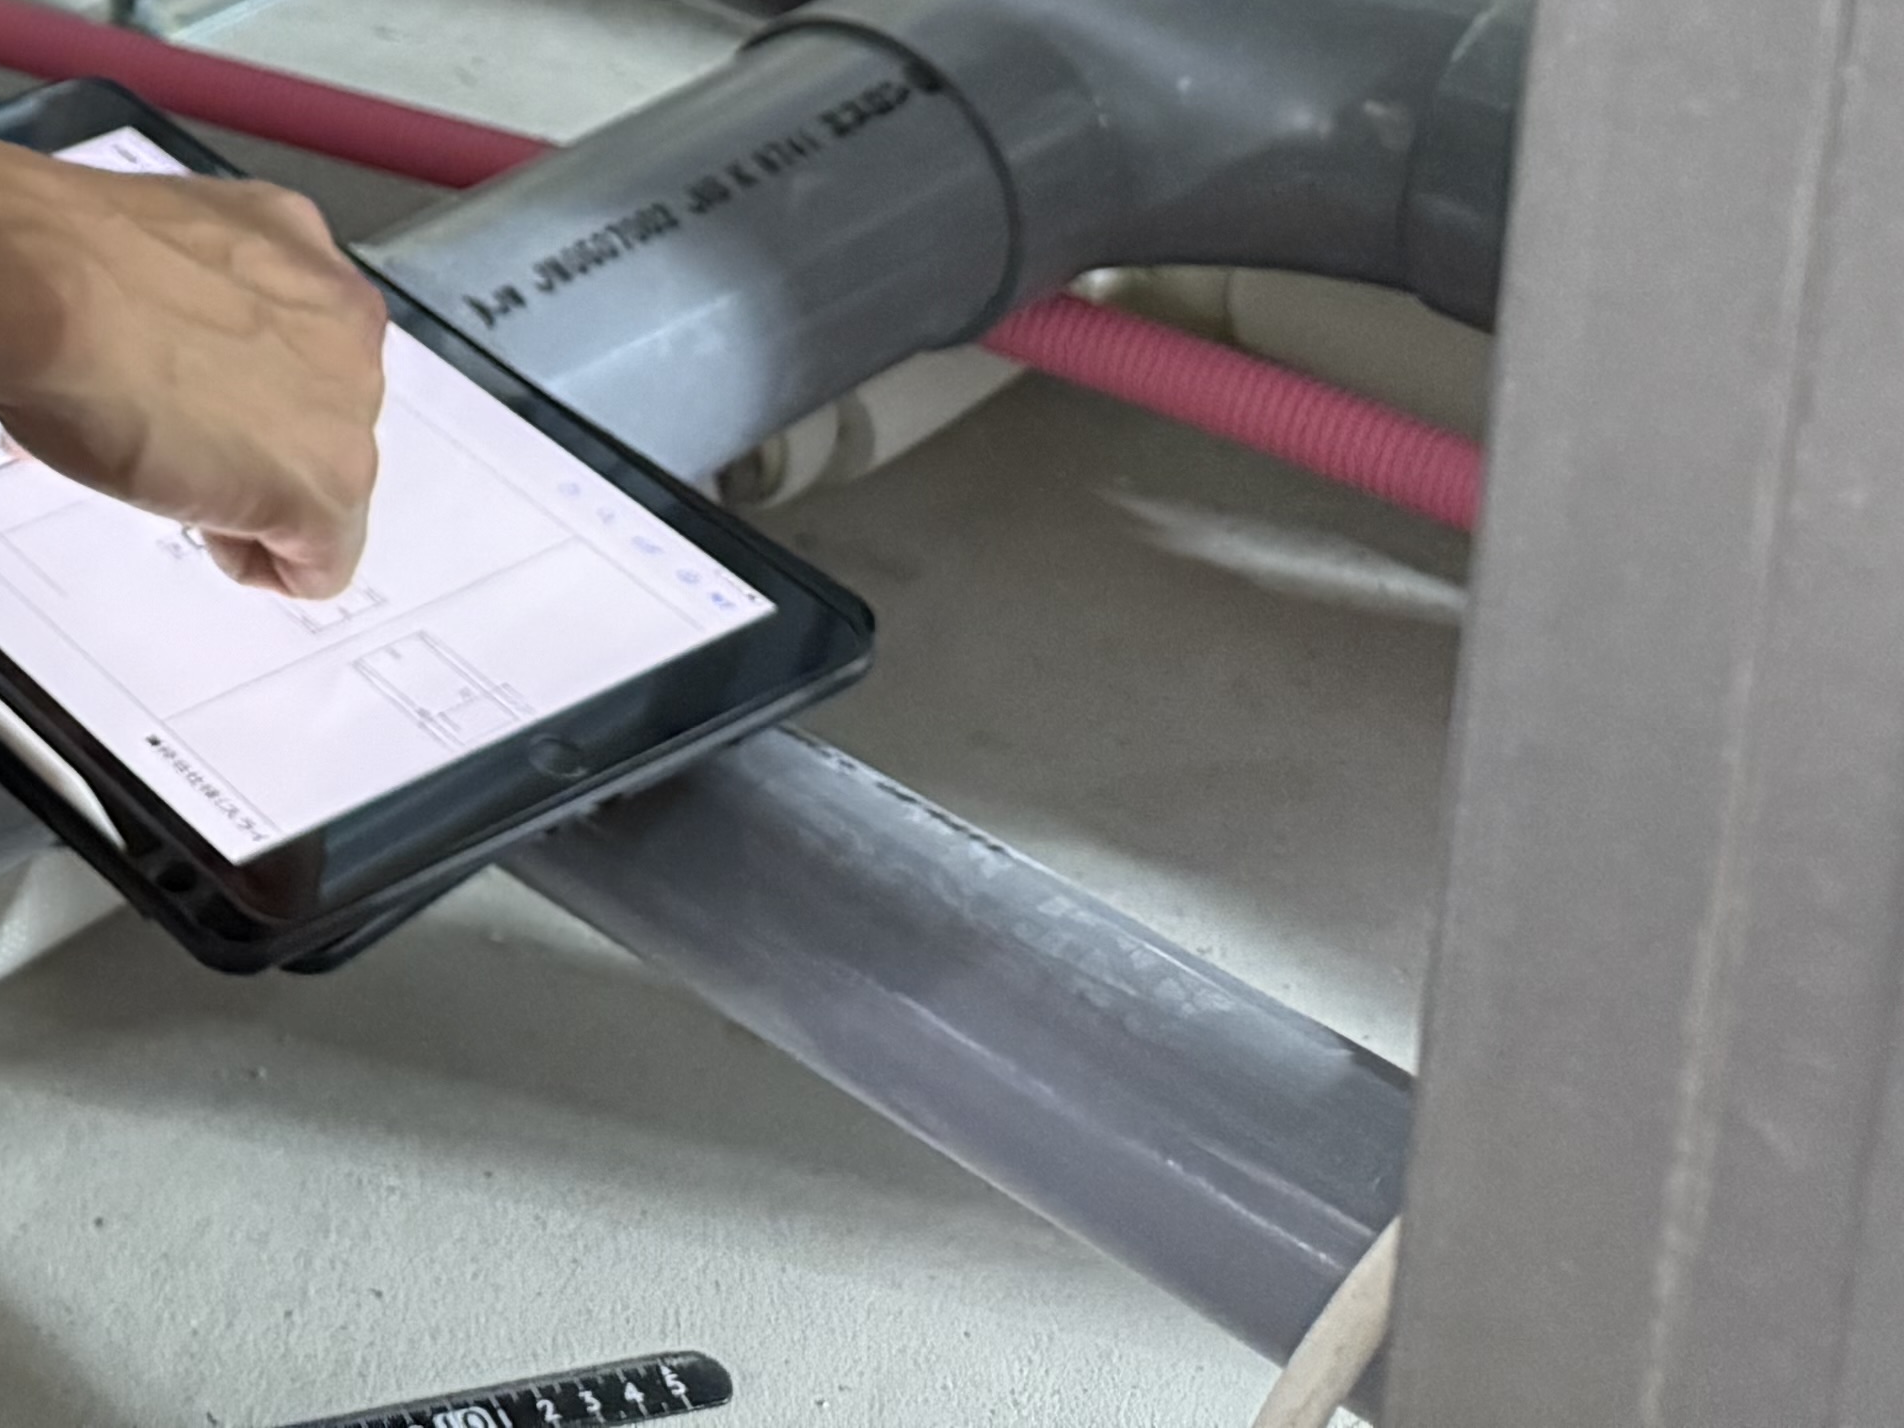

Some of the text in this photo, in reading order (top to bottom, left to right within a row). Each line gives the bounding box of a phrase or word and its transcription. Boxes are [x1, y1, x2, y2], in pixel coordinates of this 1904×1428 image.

[536, 1398, 563, 1423] 2
[578, 1390, 602, 1414] 3
[623, 1381, 645, 1403] 4
[663, 1372, 688, 1398] 5
